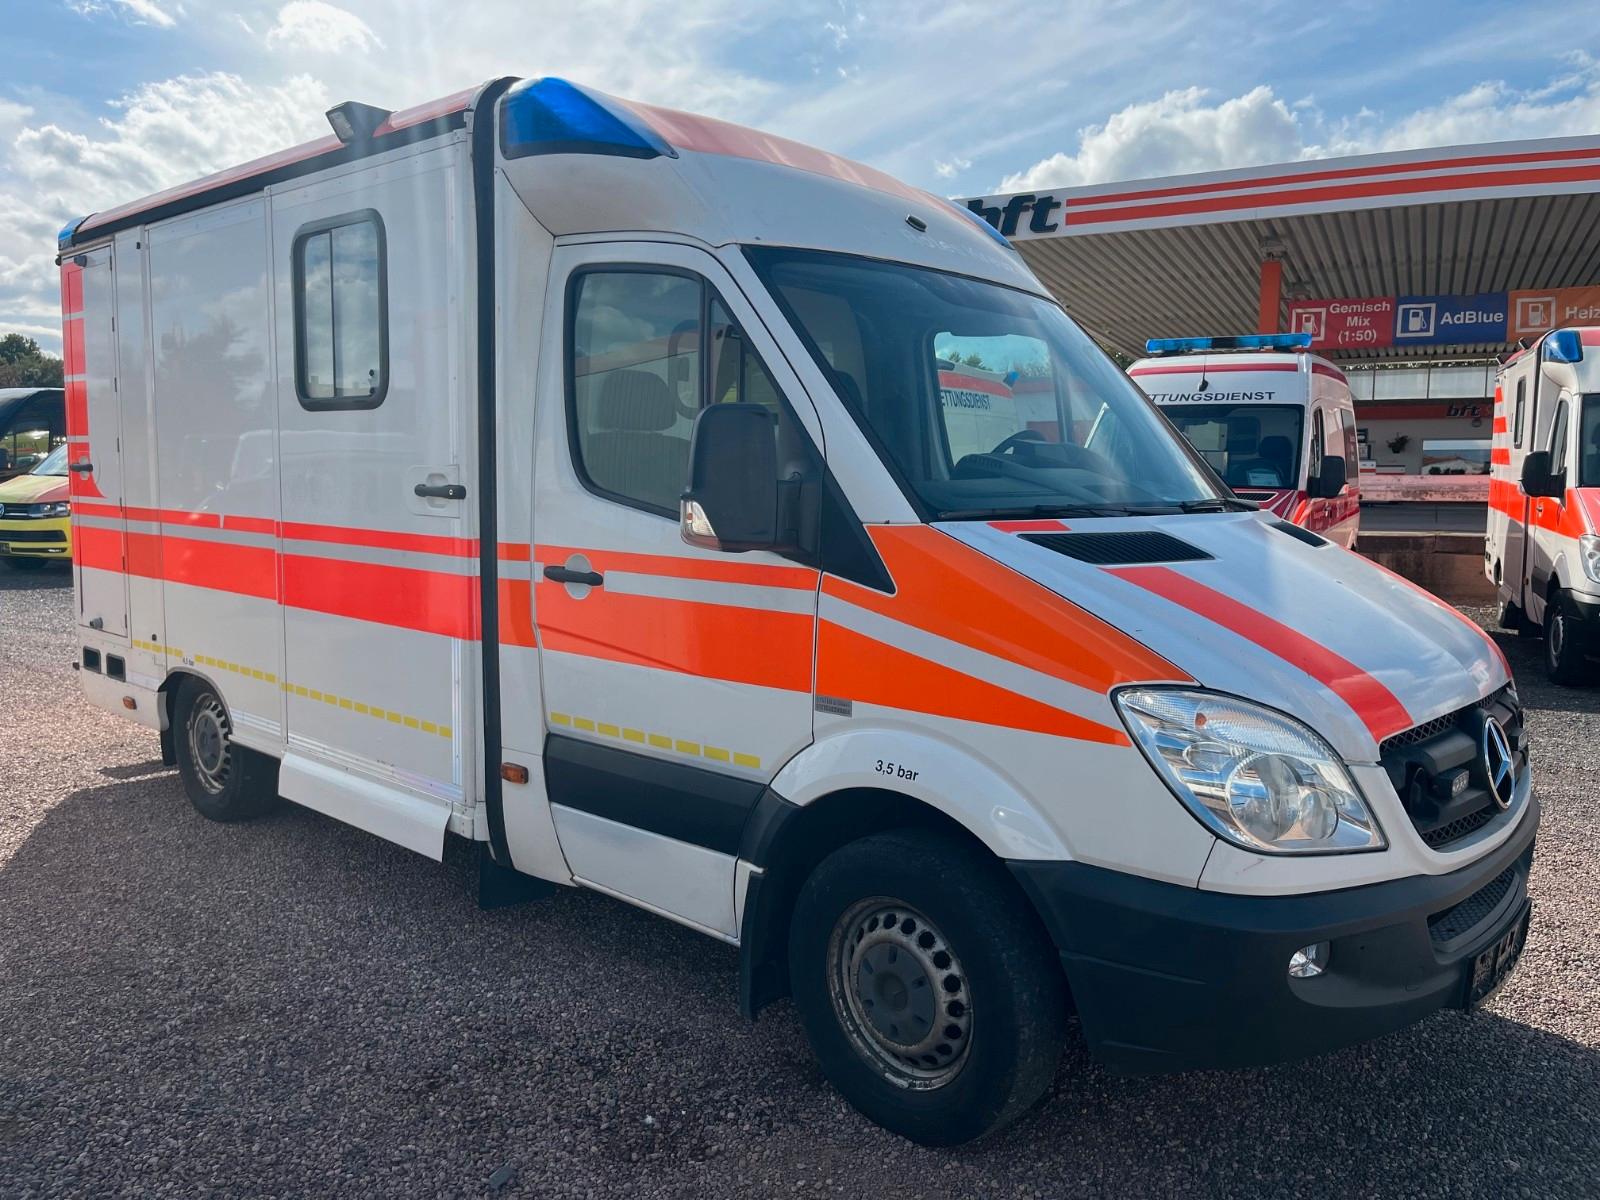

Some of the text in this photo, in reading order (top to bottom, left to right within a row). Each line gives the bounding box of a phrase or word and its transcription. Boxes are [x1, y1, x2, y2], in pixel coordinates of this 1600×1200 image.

[1330, 301, 1390, 314] Gemisch
[1346, 316, 1370, 327] Mix
[1440, 311, 1504, 325] AdBlue
[1338, 329, 1377, 345] (1:50)
[1148, 391, 1275, 402] TTUNGSDIENST
[875, 759, 919, 781] 3,5 bar
